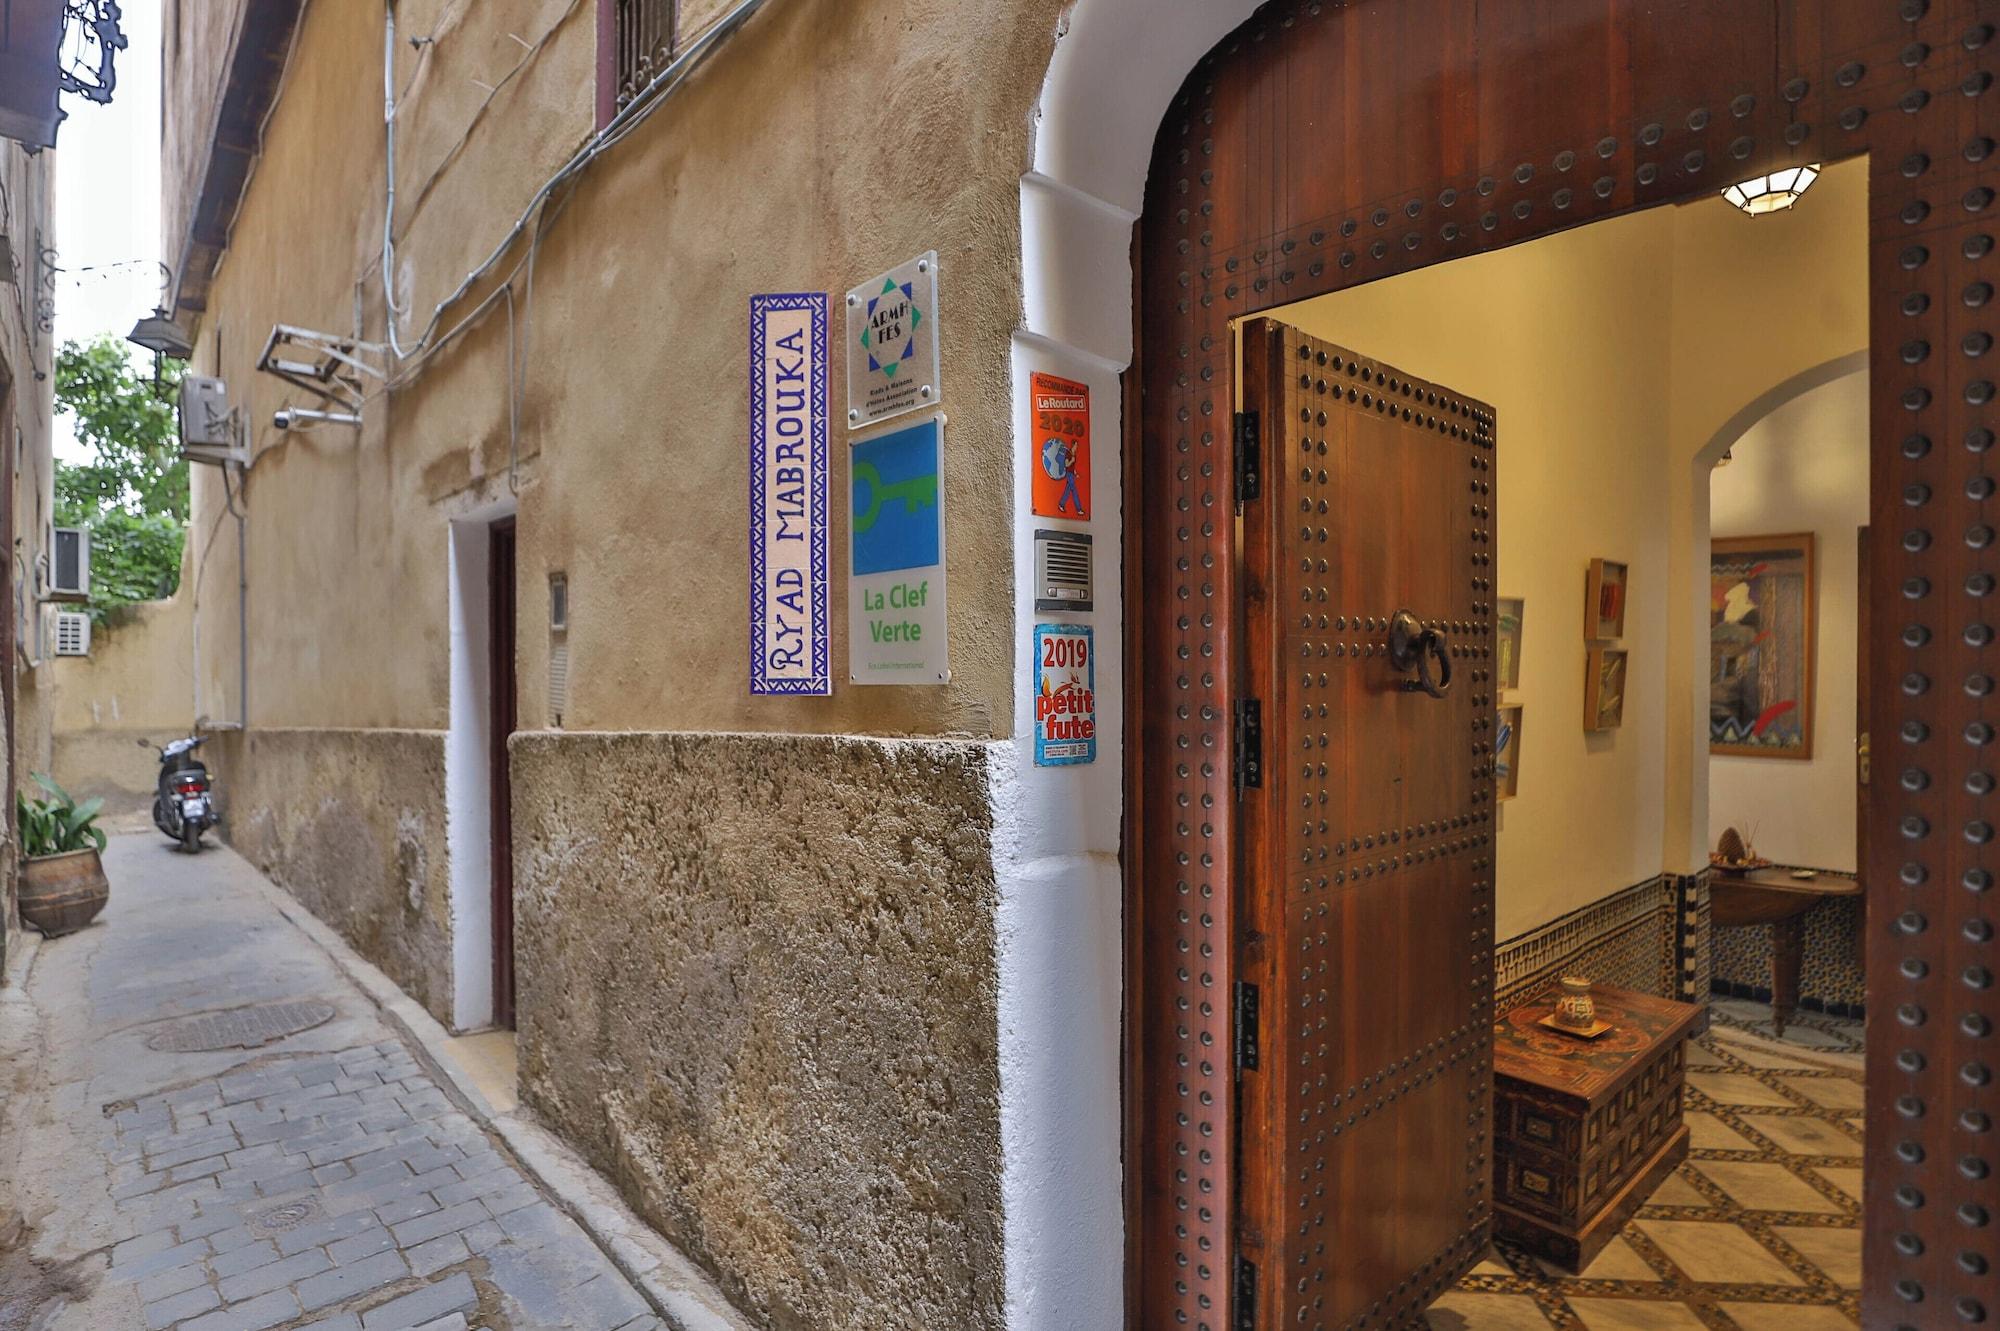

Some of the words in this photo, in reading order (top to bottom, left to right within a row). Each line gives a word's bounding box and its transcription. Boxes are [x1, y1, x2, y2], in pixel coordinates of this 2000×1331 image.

[871, 302, 909, 329] ARMH
[879, 322, 901, 344] FES
[886, 387, 918, 401] Association
[776, 328, 804, 542] MABROUKA
[1040, 412, 1085, 437] 2020
[864, 588, 885, 611] La
[889, 580, 928, 609] Clef
[769, 568, 804, 670] RYAD
[870, 619, 922, 643] Verte
[1043, 638, 1088, 668] 2019
[1037, 689, 1093, 721] petit
